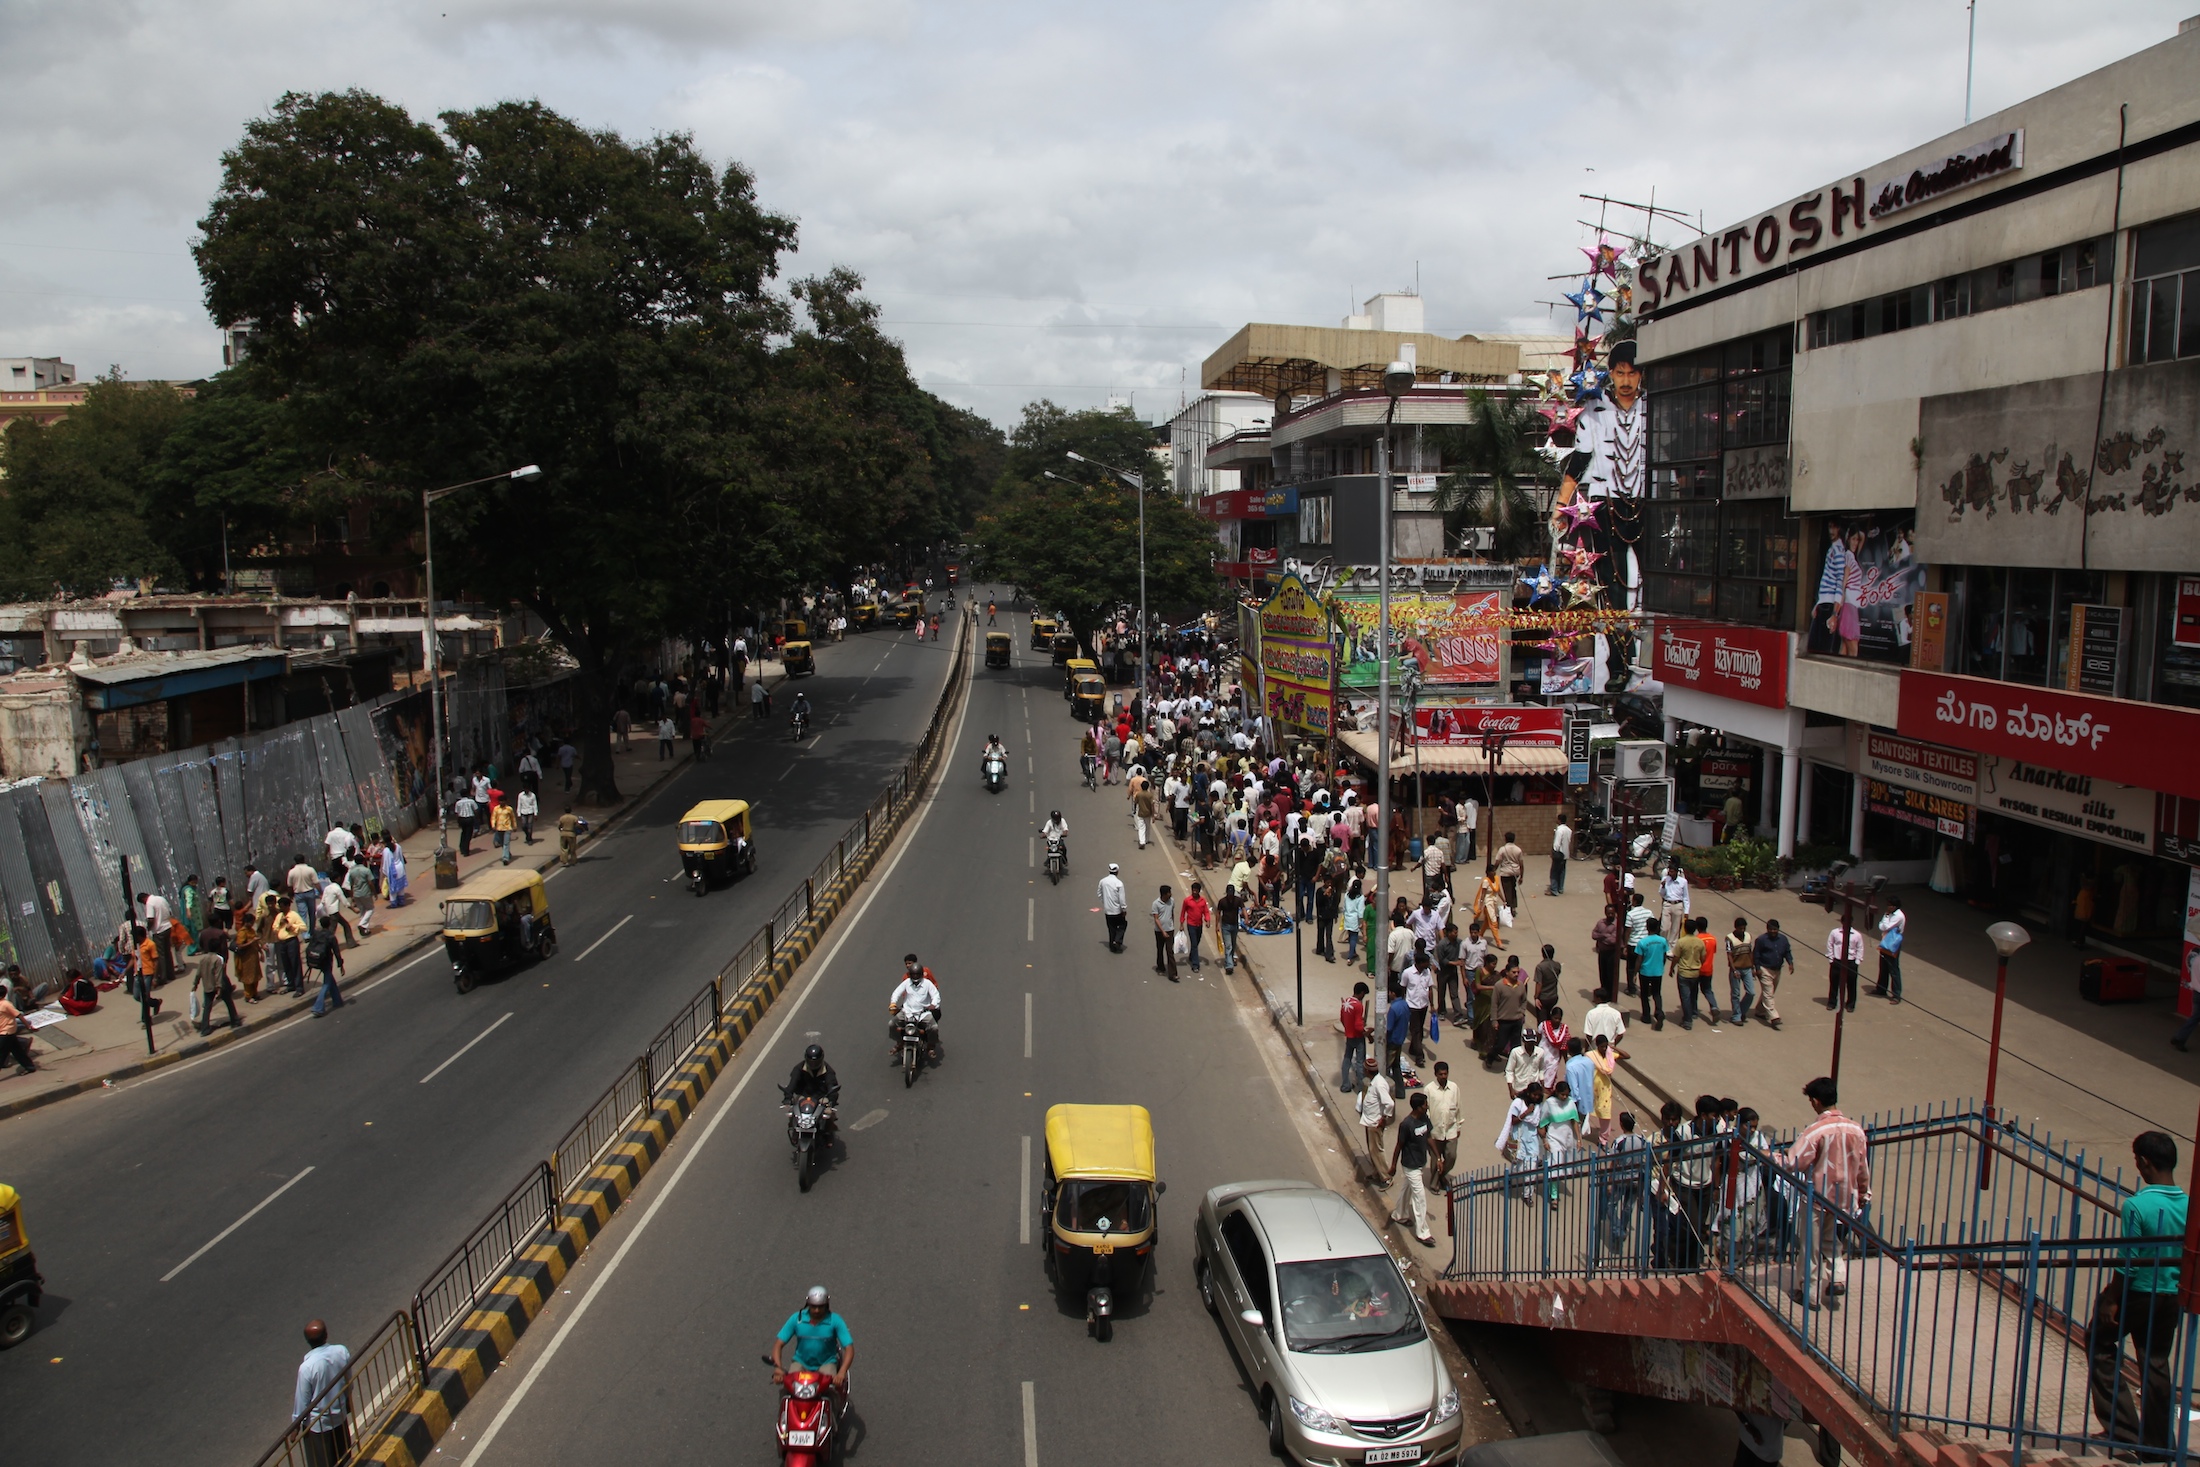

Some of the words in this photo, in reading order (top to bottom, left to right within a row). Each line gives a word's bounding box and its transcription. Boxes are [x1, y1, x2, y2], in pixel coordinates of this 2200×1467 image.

[1639, 177, 1866, 314] SANTOSH
[1437, 633, 1498, 667] 100
[1714, 637, 1727, 648] THE
[2071, 638, 2080, 675] discount
[1714, 649, 1762, 678] Raymond
[1740, 675, 1761, 690] SHOP
[1935, 689, 1998, 731] ಮೆಗಾ
[1712, 762, 1737, 773] parx
[1871, 738, 1919, 763] SANTOSH
[1922, 750, 1974, 777] TEXTILES
[1872, 760, 1902, 776] Mysore
[1904, 768, 1921, 782] Silk
[1923, 772, 1973, 795] Showroom
[2009, 761, 2091, 796] Anarkali
[1870, 781, 1890, 803] 20%
[1905, 789, 1927, 811] SILK
[1928, 796, 1965, 822] SAREES
[2082, 800, 2116, 820] silks
[1999, 797, 2038, 816] MYSORE
[2042, 808, 2083, 828] RESHAM
[2087, 819, 2145, 845] EMPORIUM
[1369, 1454, 1377, 1462] KA
[1381, 1452, 1388, 1460] 02
[1401, 1450, 1417, 1458] 5974
